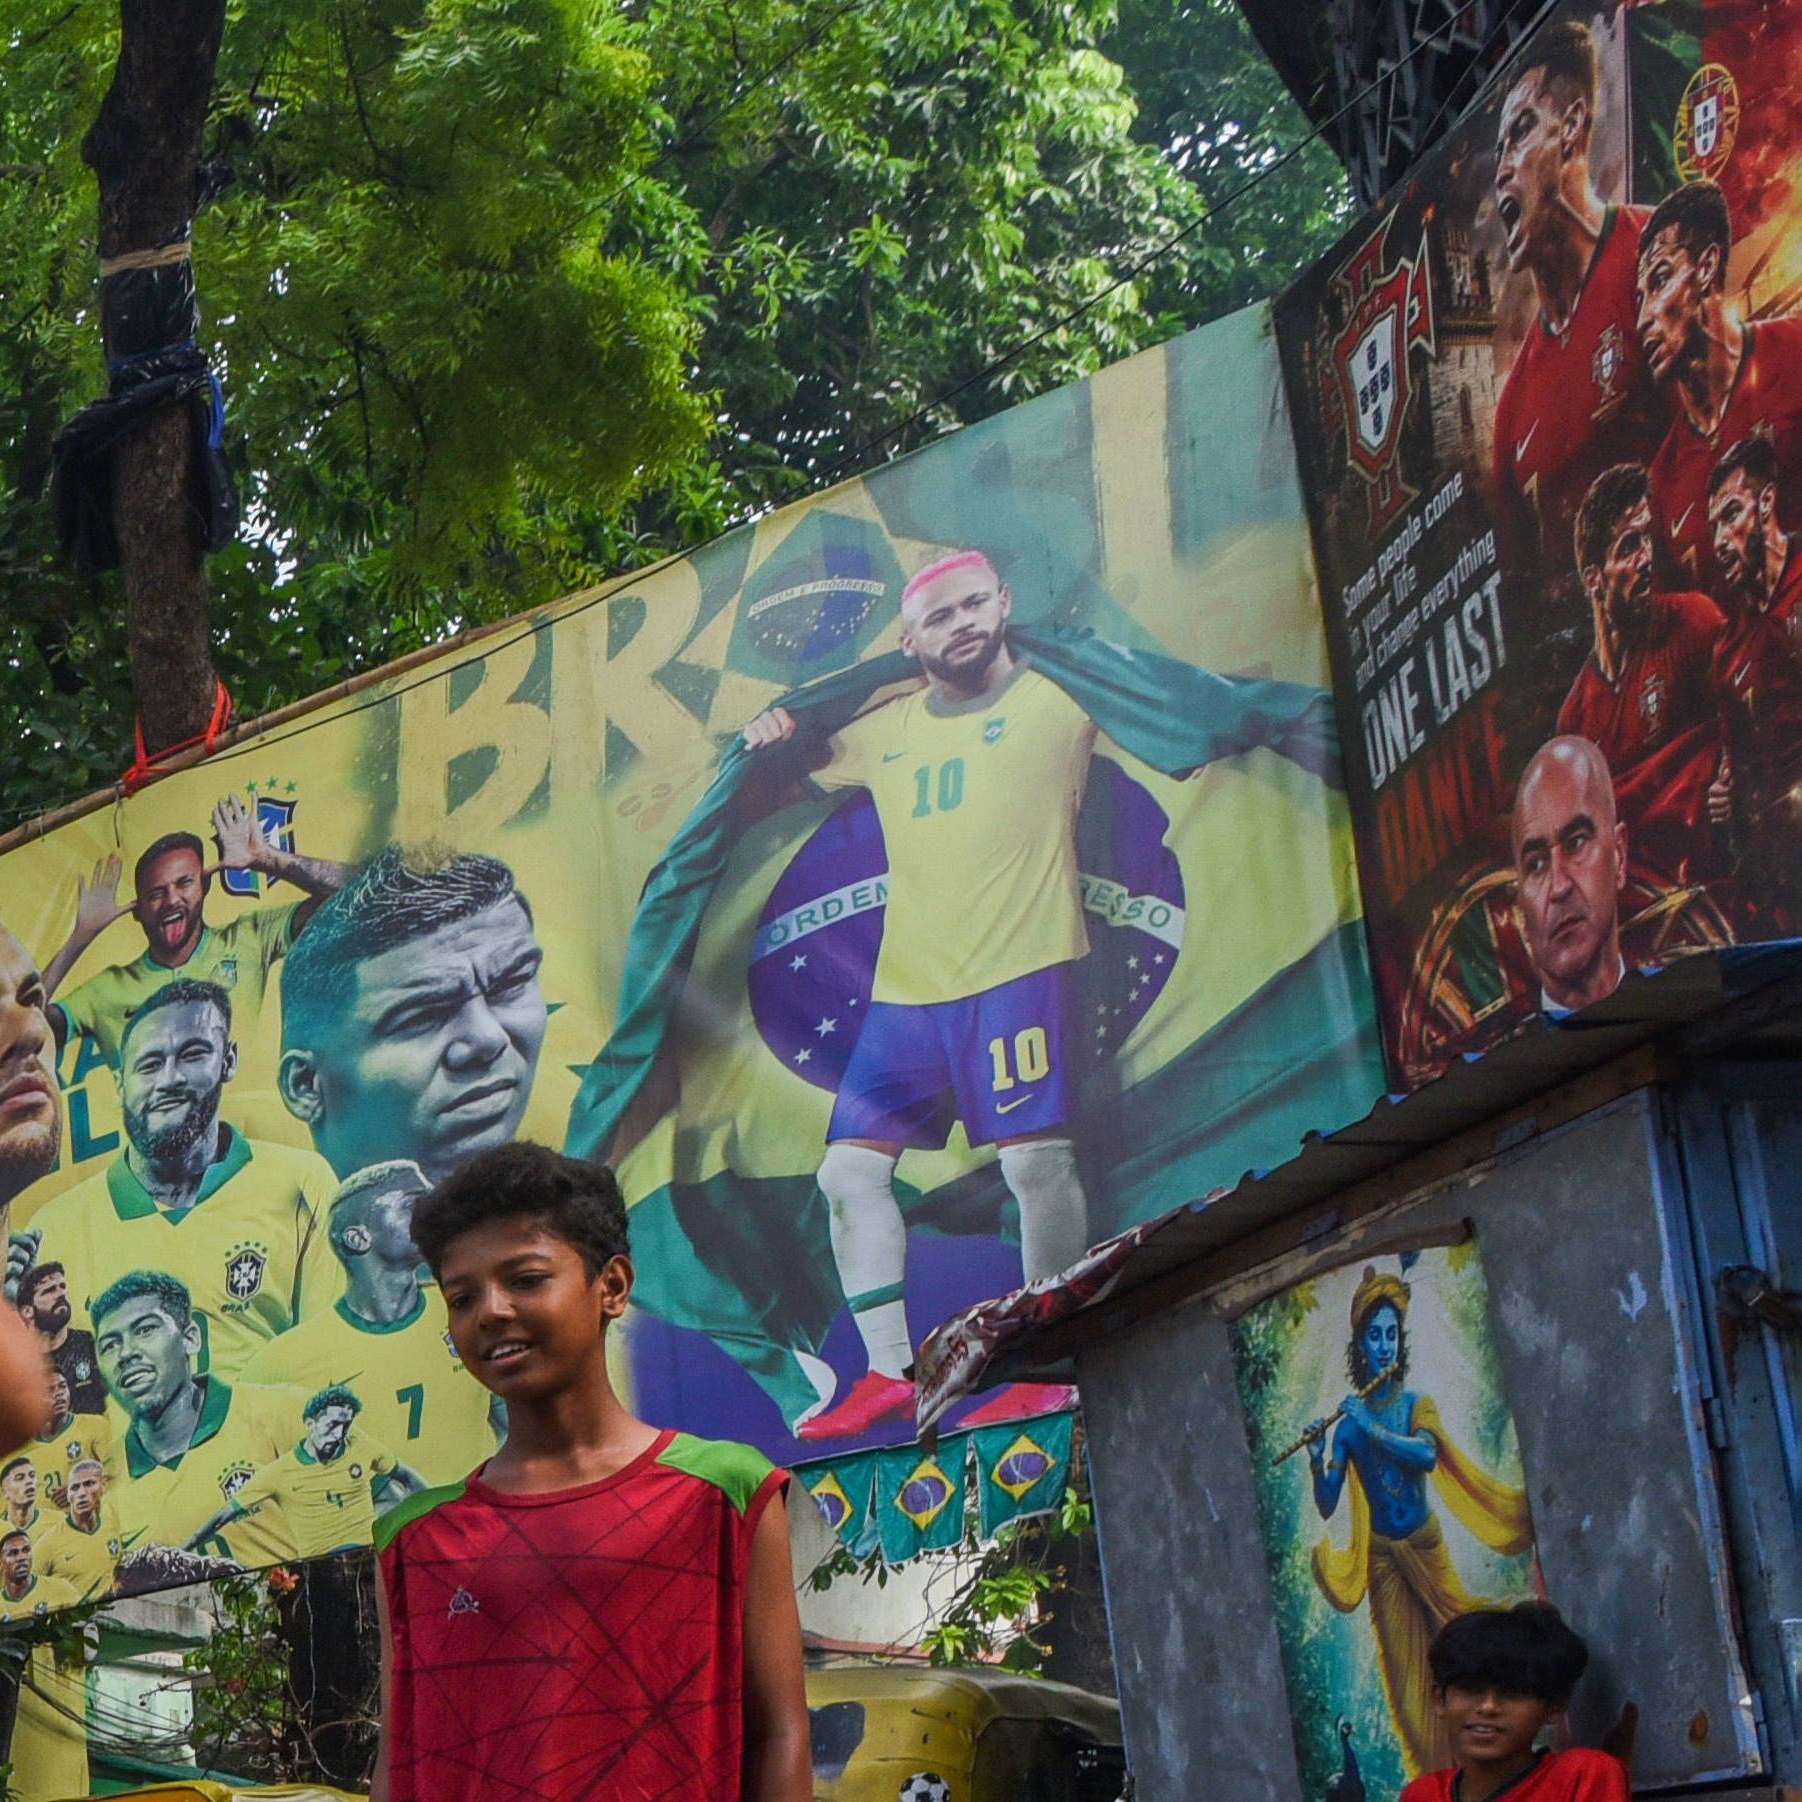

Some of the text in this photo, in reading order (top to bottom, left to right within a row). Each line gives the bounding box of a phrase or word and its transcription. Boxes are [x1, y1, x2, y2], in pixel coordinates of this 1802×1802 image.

[1342, 471, 1463, 618] Some people come
[1362, 592, 1391, 656] your
[1393, 563, 1416, 606] life
[1376, 607, 1420, 668] change
[1421, 529, 1495, 621] everything
[1363, 570, 1506, 790] ONE LAST
[911, 758, 965, 818] 10
[990, 1025, 1048, 1091] 10
[396, 1383, 424, 1440] 7
